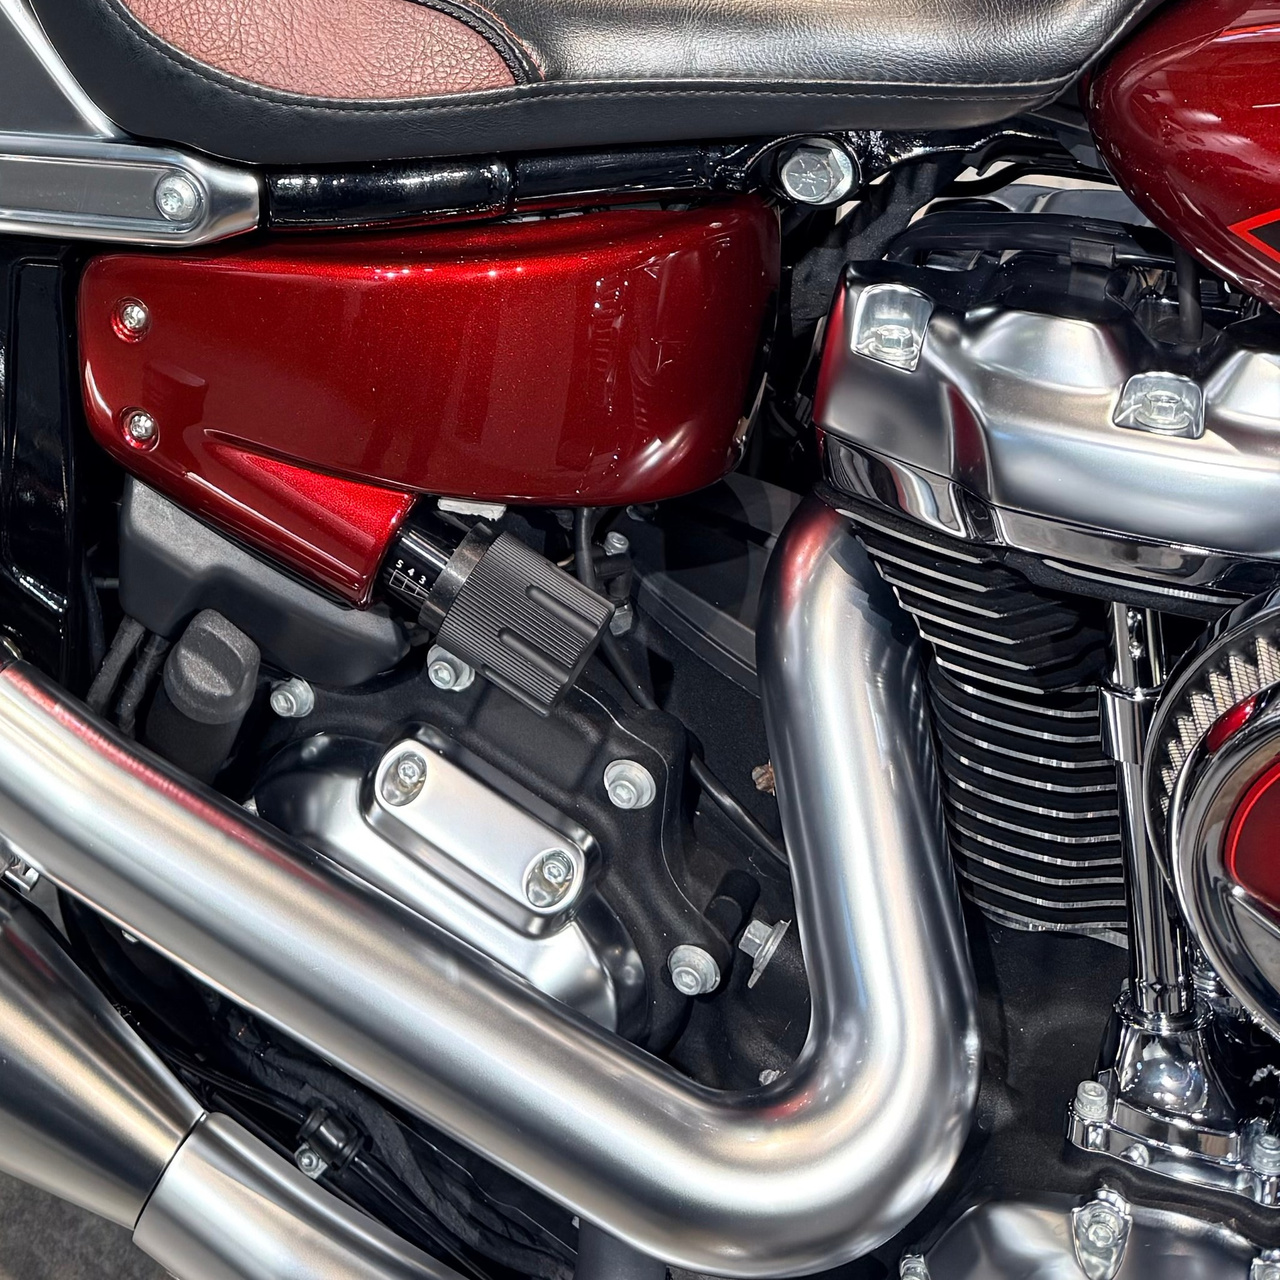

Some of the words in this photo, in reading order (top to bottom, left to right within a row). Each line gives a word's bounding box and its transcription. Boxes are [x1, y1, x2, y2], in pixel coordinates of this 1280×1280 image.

[395, 559, 404, 568] 5
[407, 568, 415, 576] 4
[418, 575, 426, 584] 3
